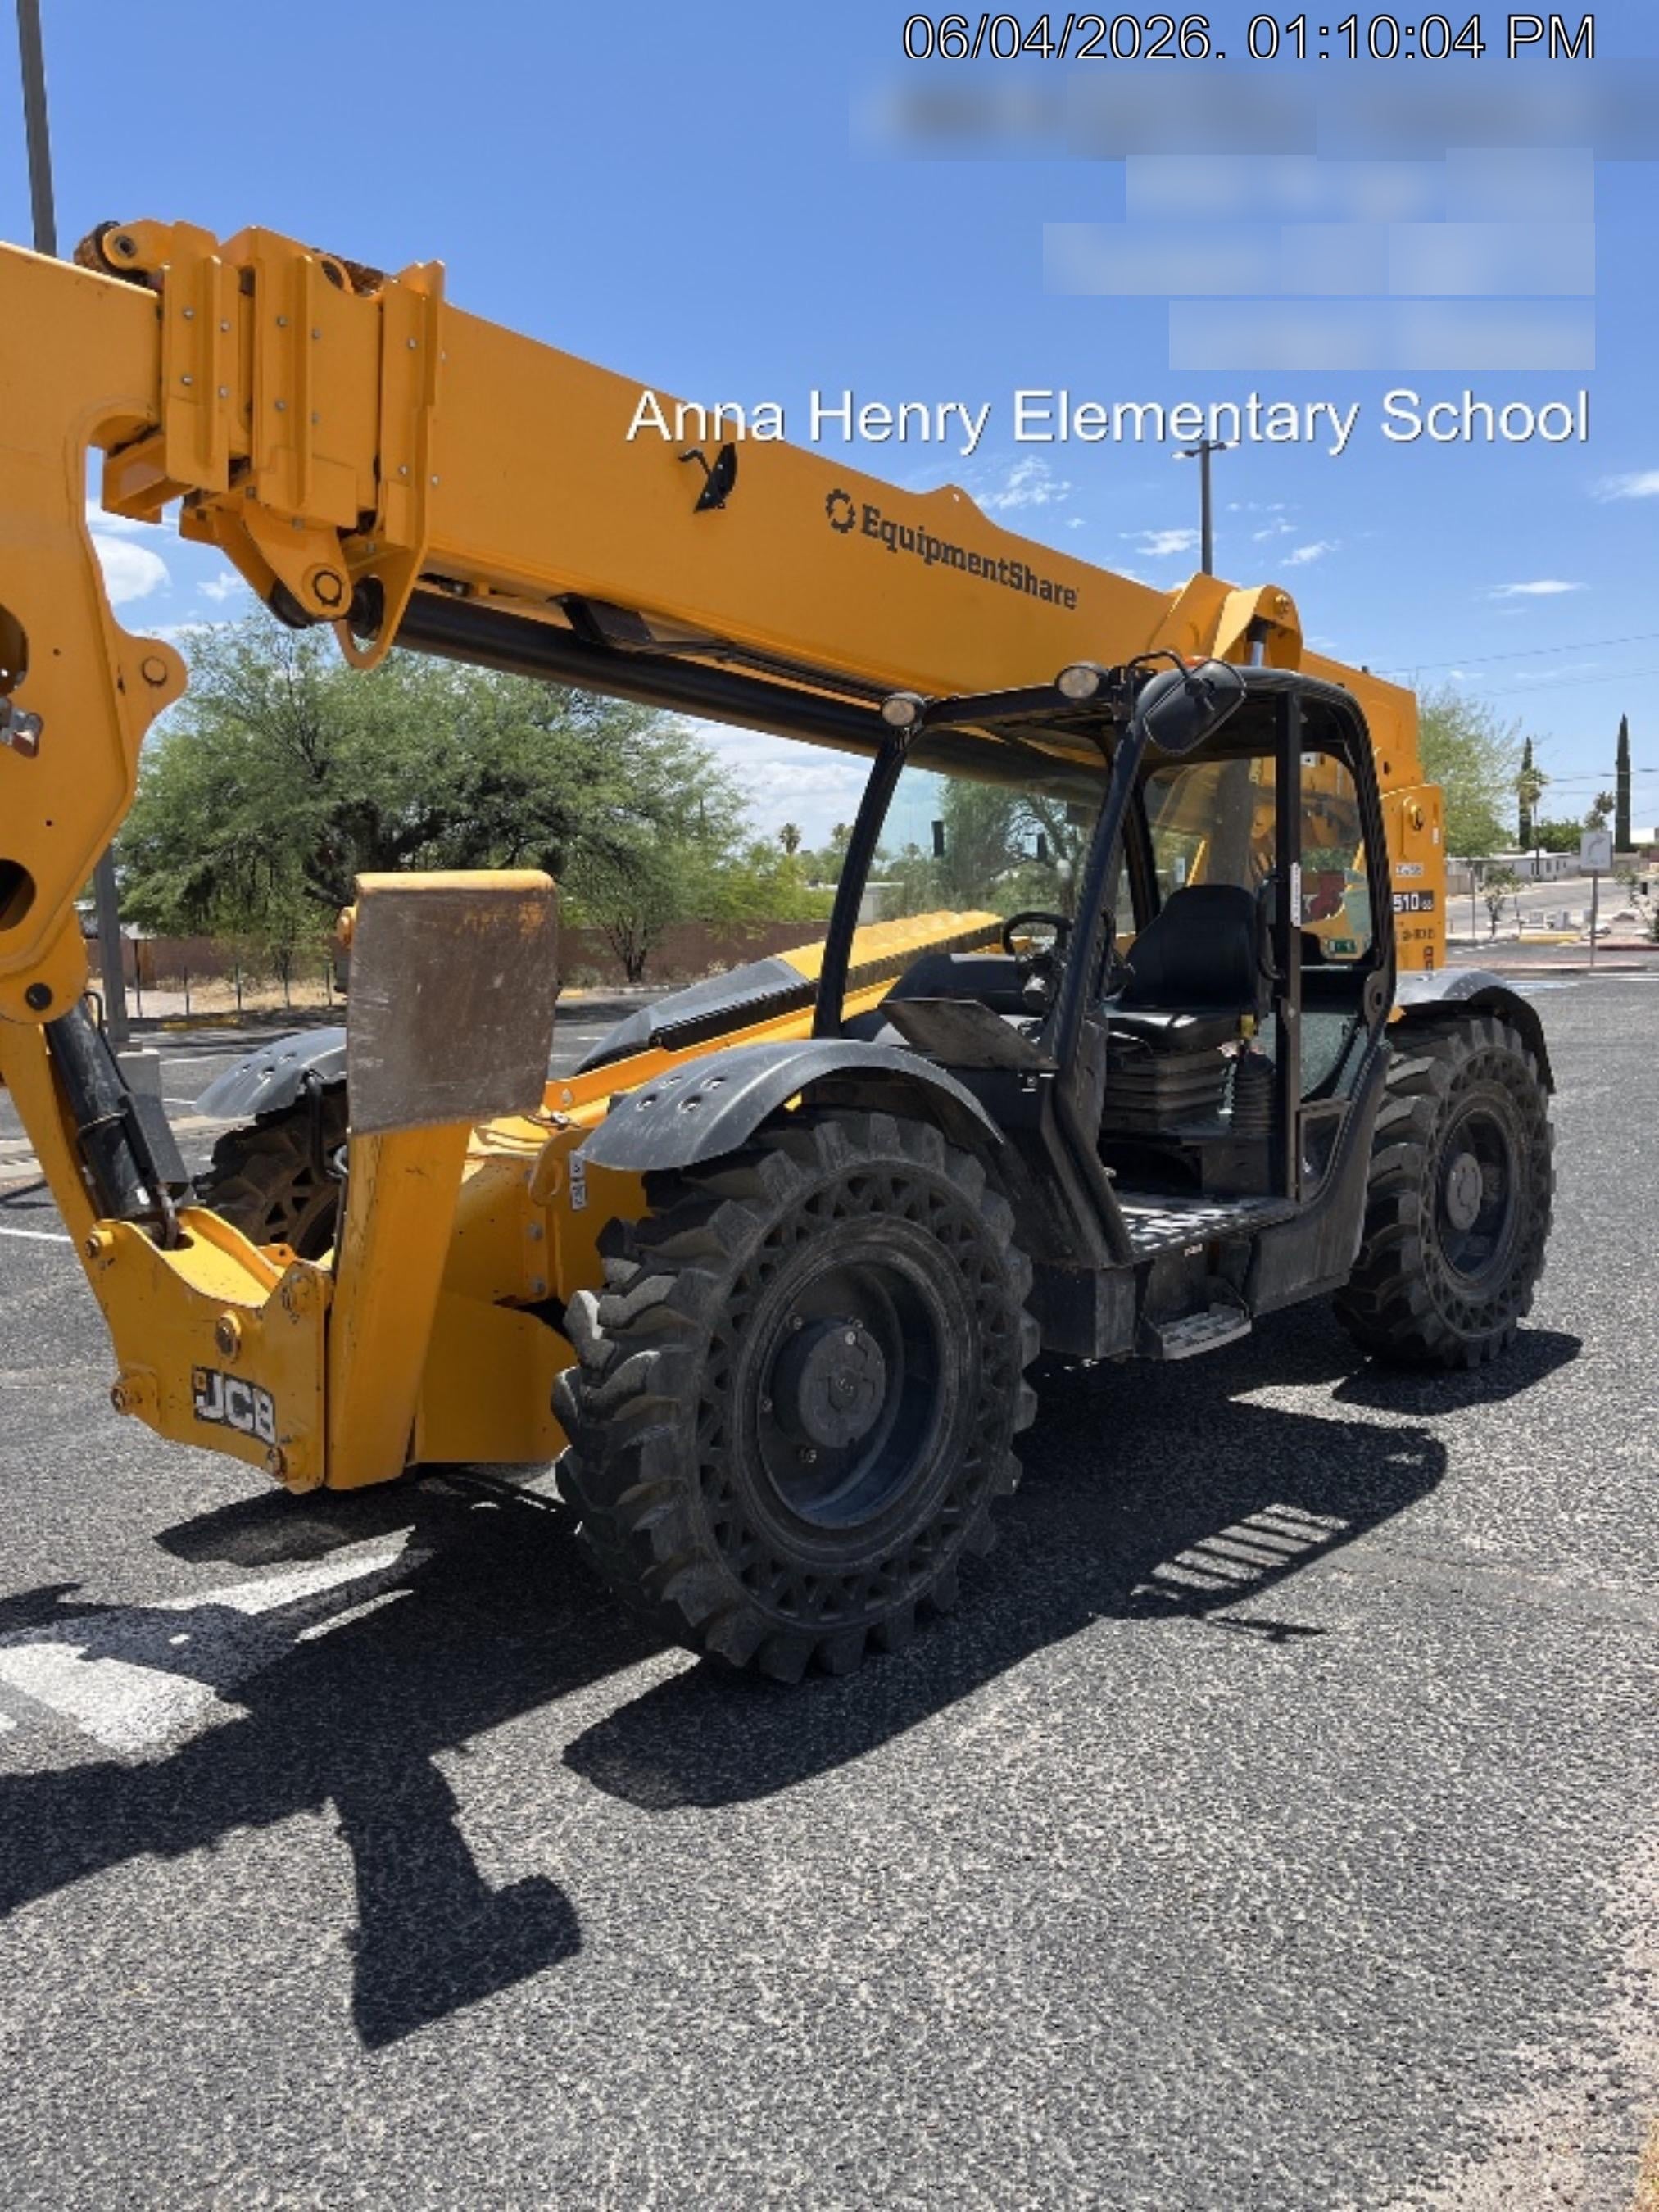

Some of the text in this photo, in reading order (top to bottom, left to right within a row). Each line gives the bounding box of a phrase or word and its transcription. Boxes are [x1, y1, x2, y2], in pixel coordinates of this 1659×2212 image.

[860, 503, 1077, 610] EquipmentShare
[1394, 892, 1420, 912] 510
[194, 1368, 276, 1444] JCB
